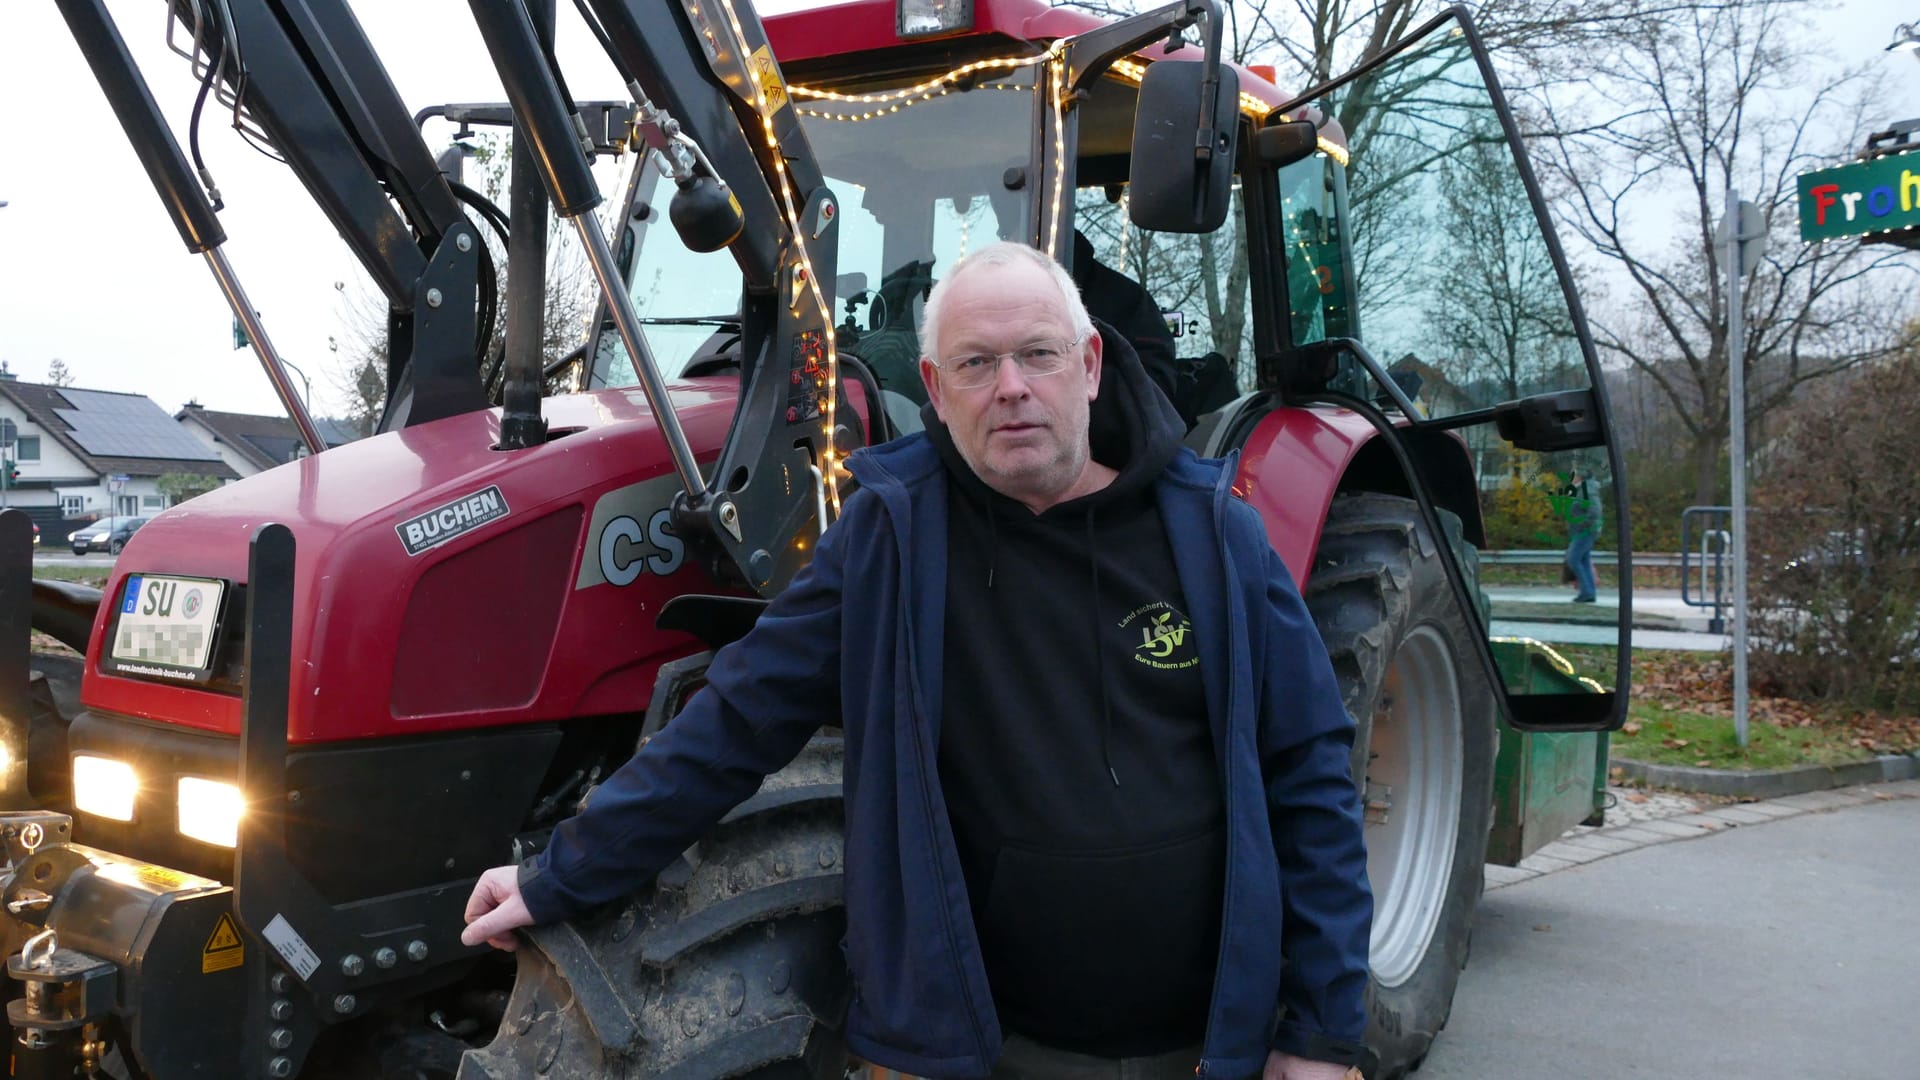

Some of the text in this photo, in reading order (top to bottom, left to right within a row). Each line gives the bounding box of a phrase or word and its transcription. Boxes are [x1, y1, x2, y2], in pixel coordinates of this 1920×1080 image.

[406, 490, 499, 546] BUCHEN
[599, 508, 685, 587] CS
[127, 600, 134, 611] D
[143, 581, 177, 617] SU
[1118, 611, 1137, 628] Land
[1136, 601, 1164, 615] sichert
[117, 663, 196, 680] www.landtechnik-buchen.de
[1134, 653, 1152, 665] Eure
[1152, 660, 1178, 669] Bauern
